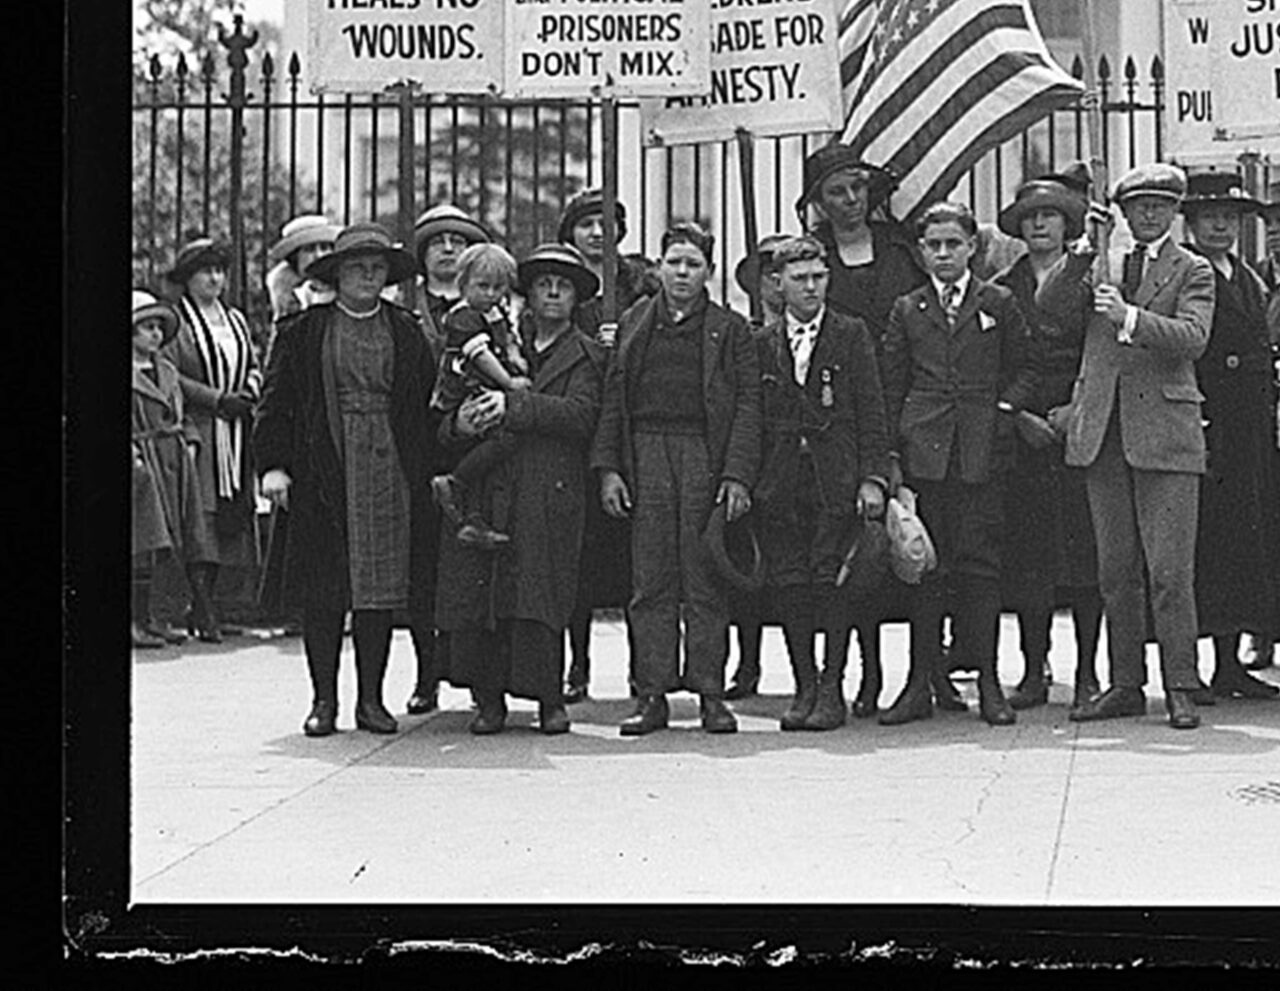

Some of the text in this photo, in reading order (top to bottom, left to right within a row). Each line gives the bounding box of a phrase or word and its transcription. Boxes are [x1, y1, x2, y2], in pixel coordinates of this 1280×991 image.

[341, 23, 484, 60] WOUNDS.
[544, 12, 682, 43] PRISONERS
[774, 13, 824, 49] FOR
[521, 47, 683, 77] DON'T MIX.
[664, 61, 807, 110] NESTY.
